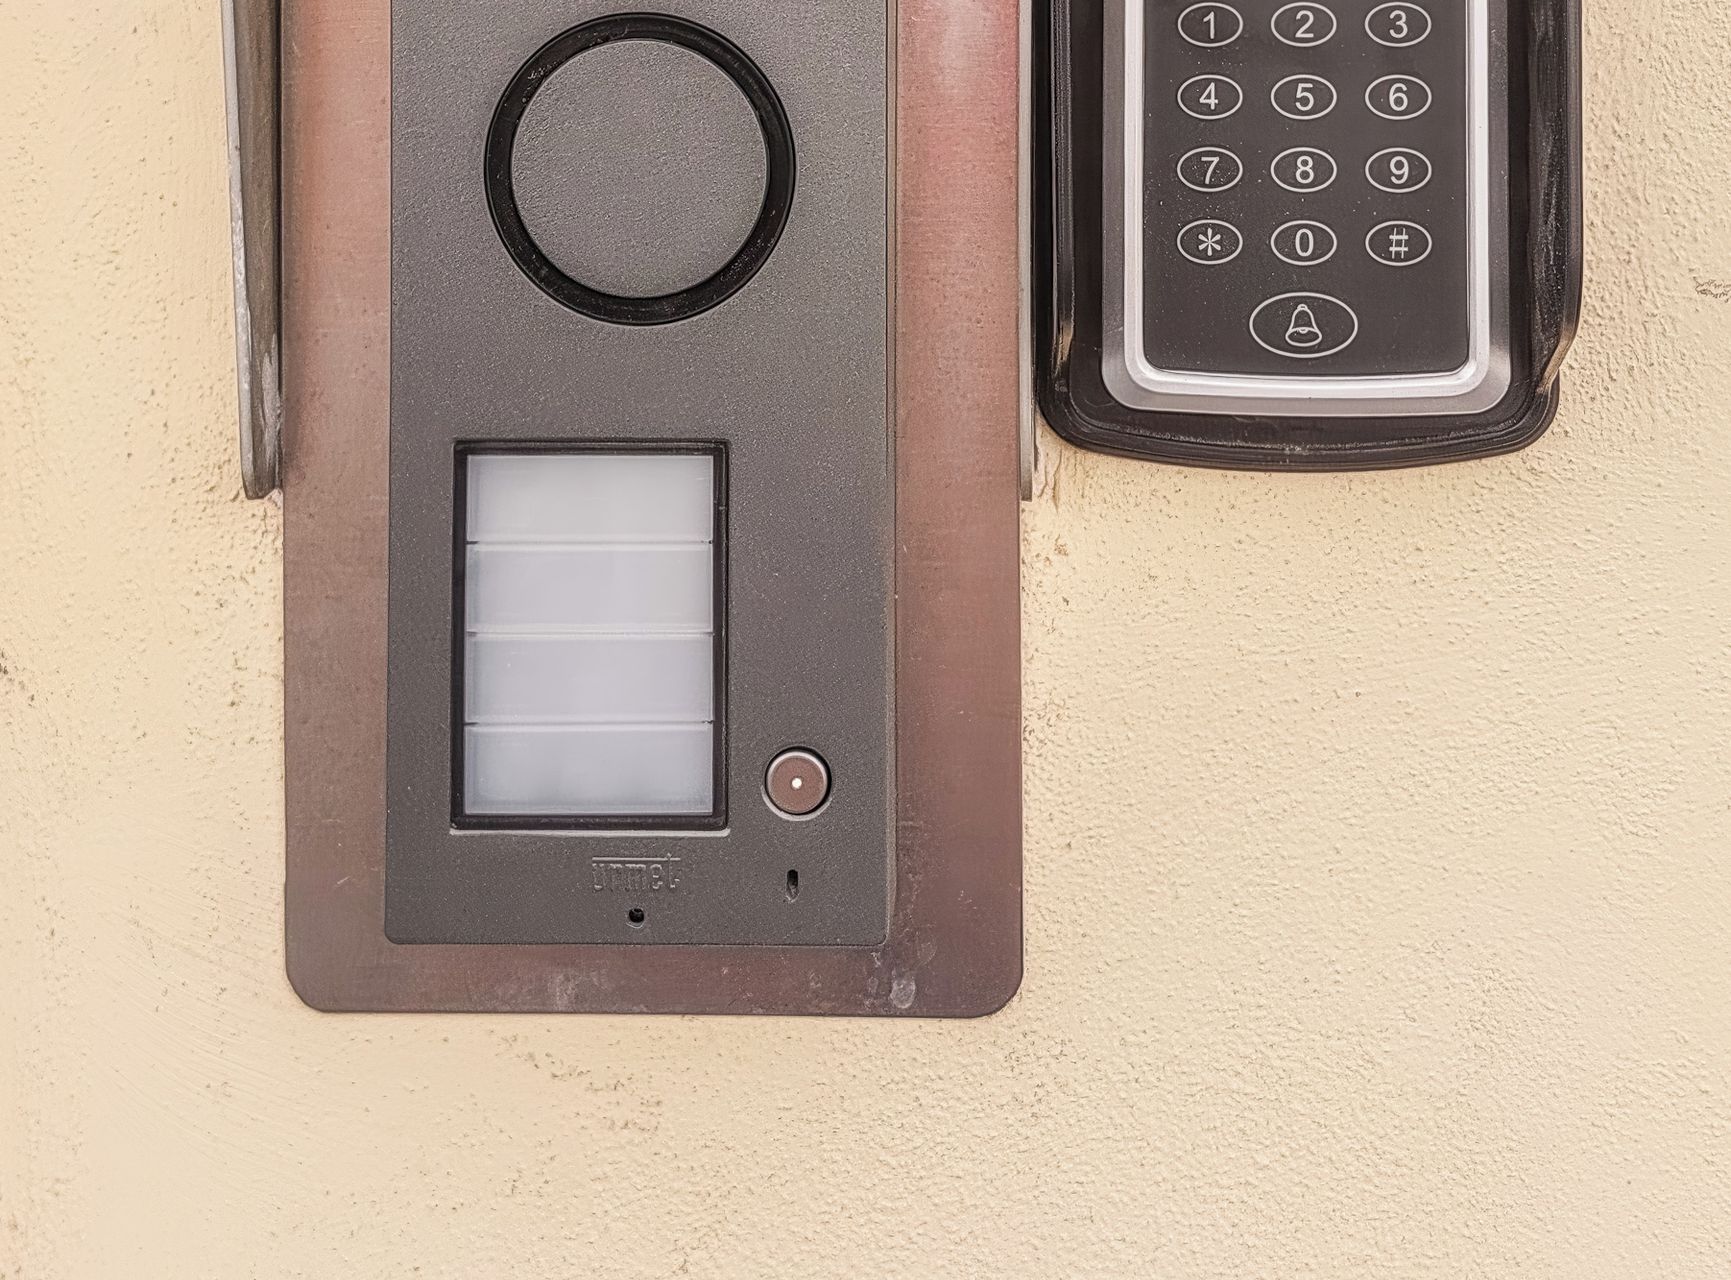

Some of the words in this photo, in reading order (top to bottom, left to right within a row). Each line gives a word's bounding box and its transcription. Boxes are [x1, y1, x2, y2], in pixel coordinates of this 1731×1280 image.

[1202, 11, 1215, 39] 1
[1295, 9, 1315, 38] 2
[1389, 9, 1408, 39] 3
[1199, 81, 1219, 110] 4
[1295, 82, 1315, 112] 5
[1388, 82, 1409, 112] 6
[1200, 156, 1220, 185] 7
[1295, 155, 1315, 184] 8
[1389, 155, 1409, 185] 9
[1294, 228, 1314, 257] 0
[1388, 227, 1409, 259] #
